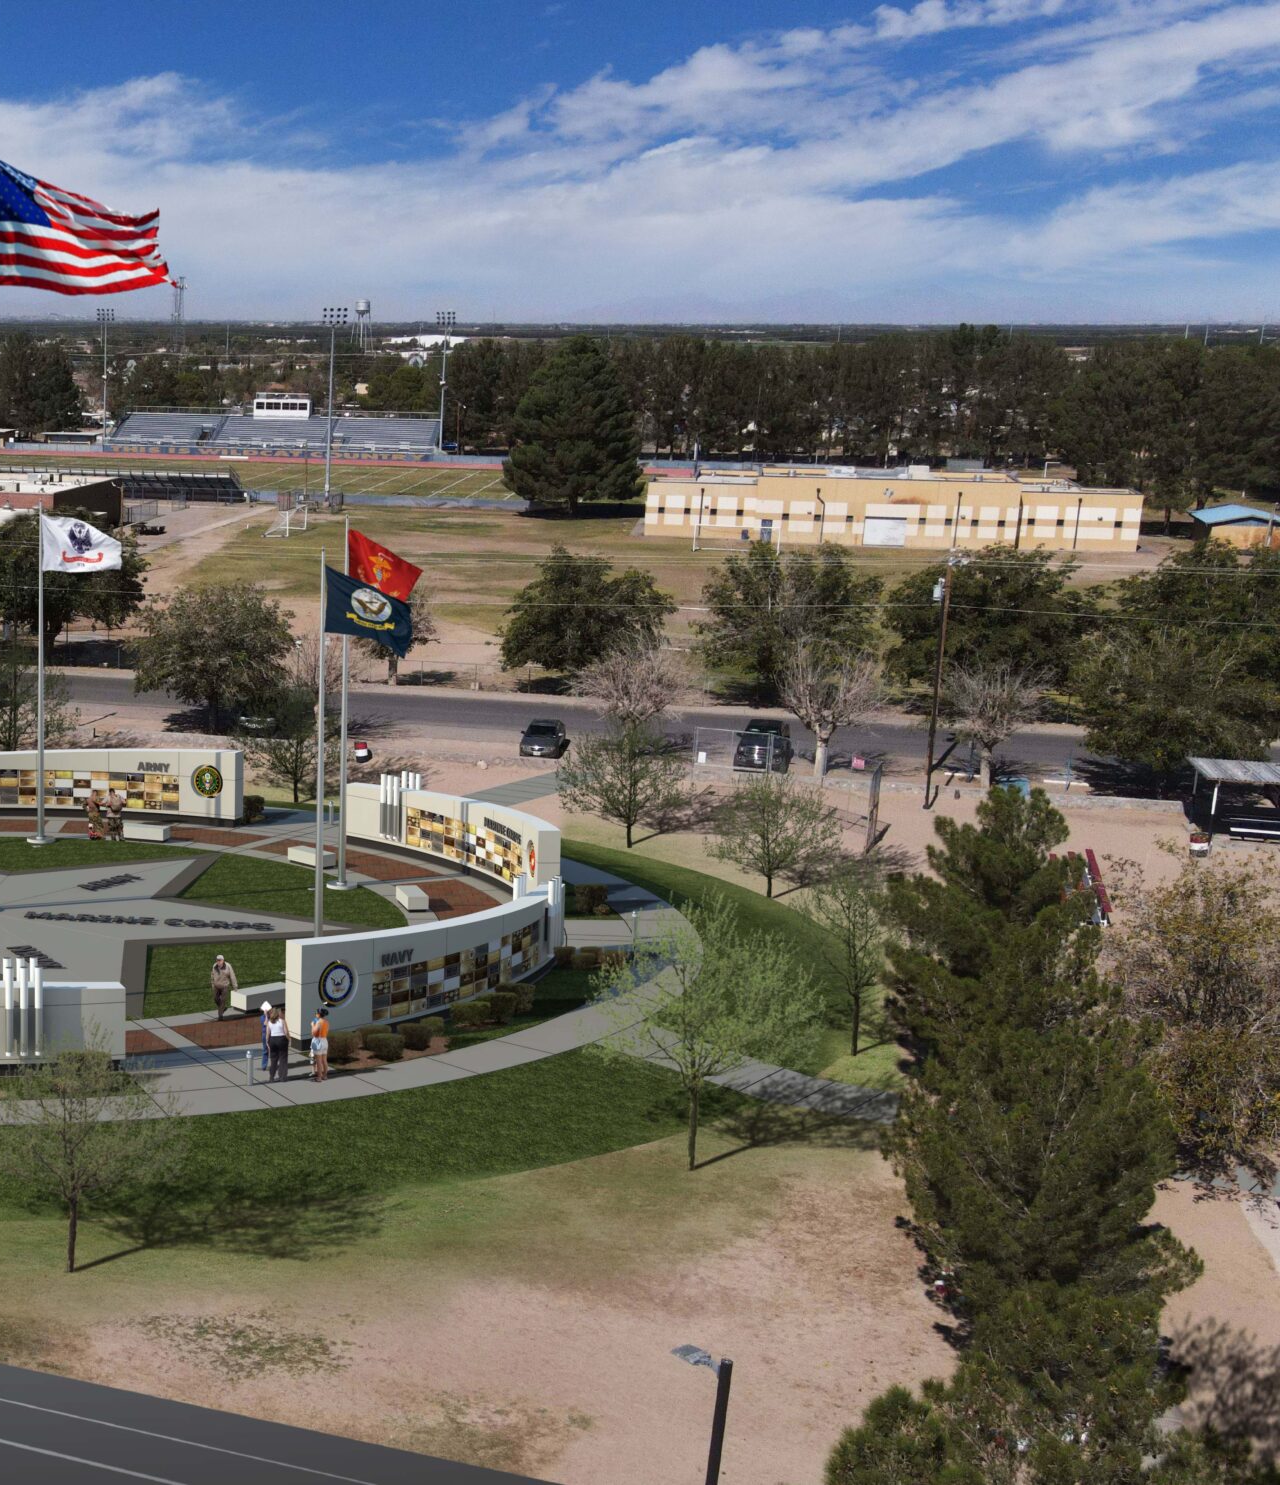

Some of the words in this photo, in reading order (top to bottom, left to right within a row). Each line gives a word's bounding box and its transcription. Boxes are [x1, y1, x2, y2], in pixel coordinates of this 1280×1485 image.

[111, 445, 161, 453] THIS
[198, 448, 304, 457] WILDCAT
[310, 451, 427, 461] COUNTRY
[137, 761, 170, 773] ARMY
[23, 910, 159, 926] MARINE
[164, 918, 275, 932] CORPS
[382, 948, 414, 967] NAVY
